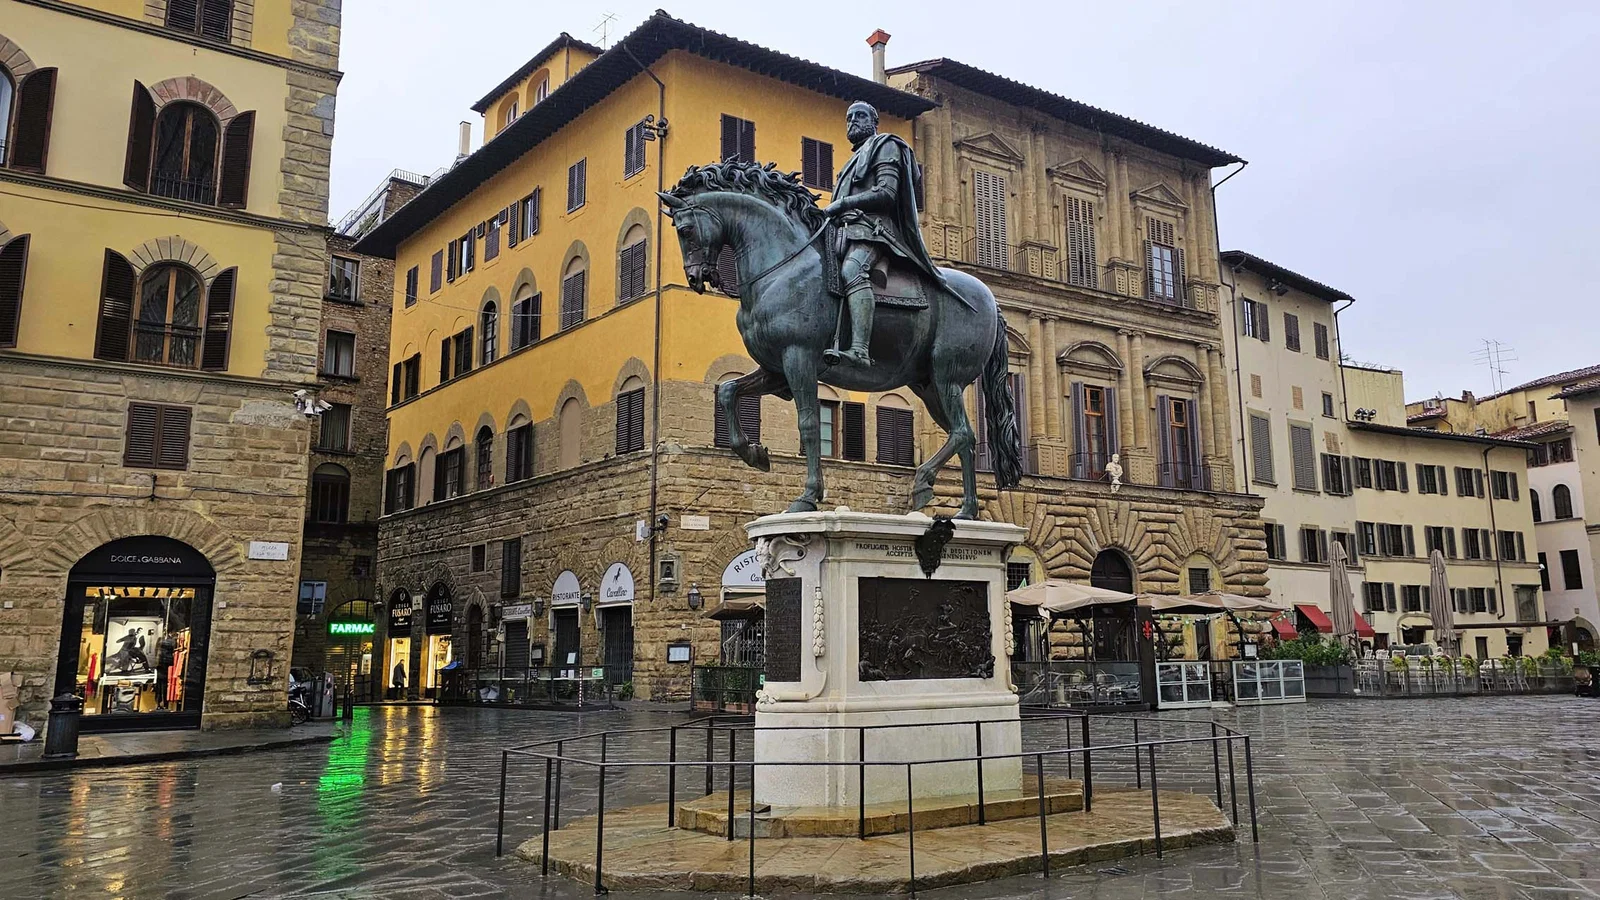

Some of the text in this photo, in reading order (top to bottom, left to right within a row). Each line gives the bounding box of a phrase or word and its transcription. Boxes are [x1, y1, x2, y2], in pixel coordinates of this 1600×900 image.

[552, 591, 580, 600] RISTORANTE
[391, 607, 412, 618] FUSARO
[430, 602, 452, 614] FUSARO
